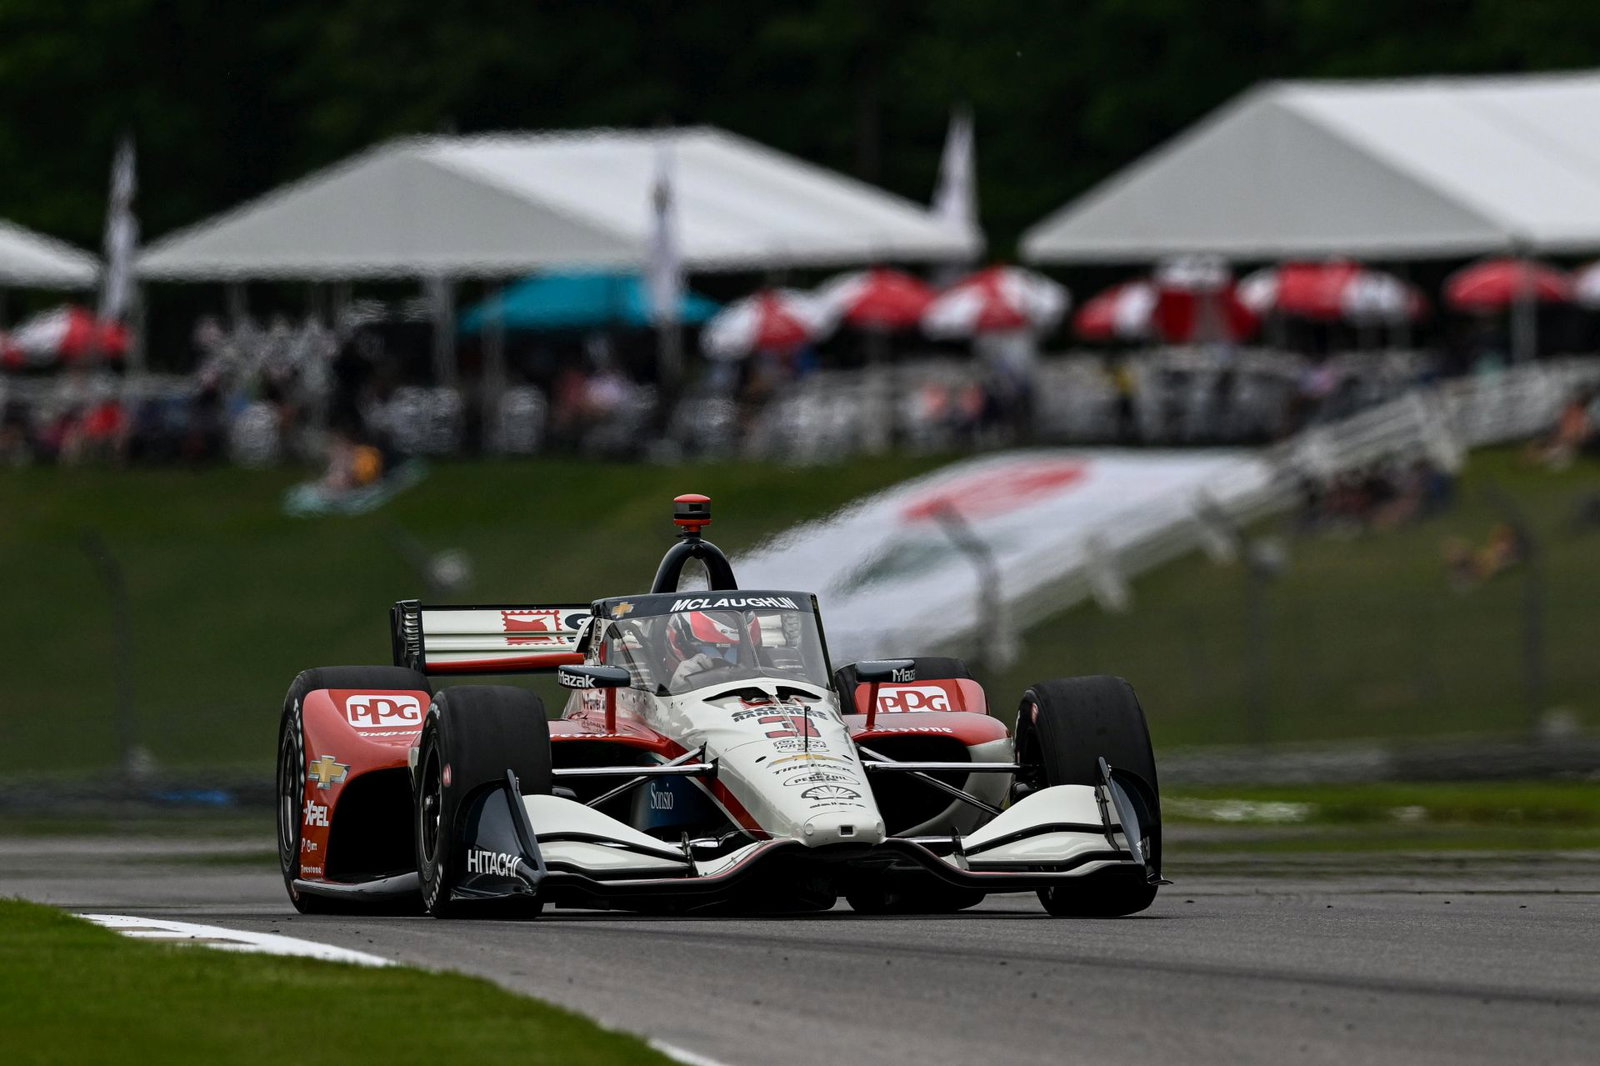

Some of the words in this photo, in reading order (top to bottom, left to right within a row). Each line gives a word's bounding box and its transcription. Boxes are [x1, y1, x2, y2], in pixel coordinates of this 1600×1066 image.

[670, 596, 799, 613] MCLAUGHLIN
[558, 669, 596, 688] Mazak
[350, 698, 419, 725] PPG
[878, 690, 945, 712] PPG
[650, 782, 674, 810] Sonsio
[304, 799, 329, 827] XPEL
[467, 849, 523, 877] HITACHI
